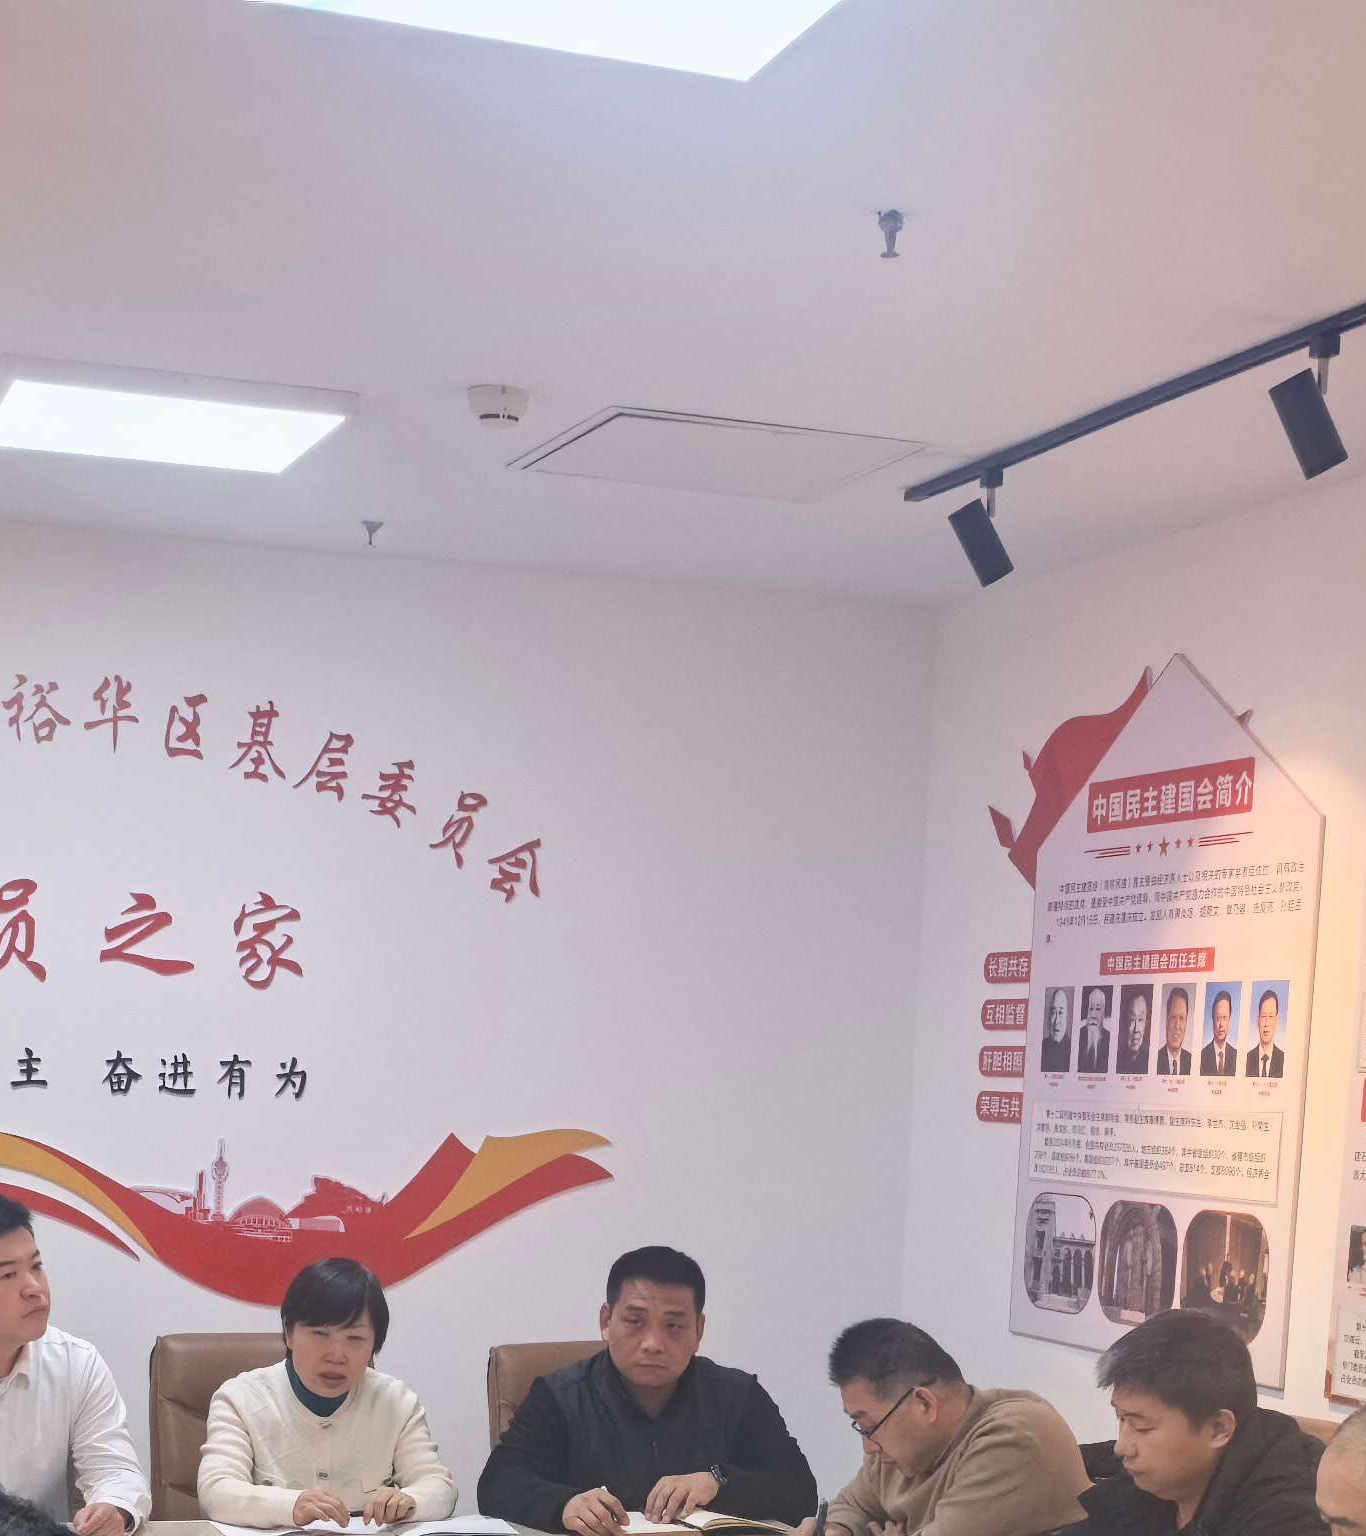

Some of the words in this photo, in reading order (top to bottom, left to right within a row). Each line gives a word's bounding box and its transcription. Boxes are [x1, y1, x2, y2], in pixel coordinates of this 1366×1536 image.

[1092, 771, 1254, 827] 中国民主建国会简介
[988, 955, 1029, 978] 长期共存
[985, 1003, 1026, 1025] 互相监督
[982, 1049, 1023, 1072] 肝胆相照
[102, 1048, 309, 1100] 奋进有为
